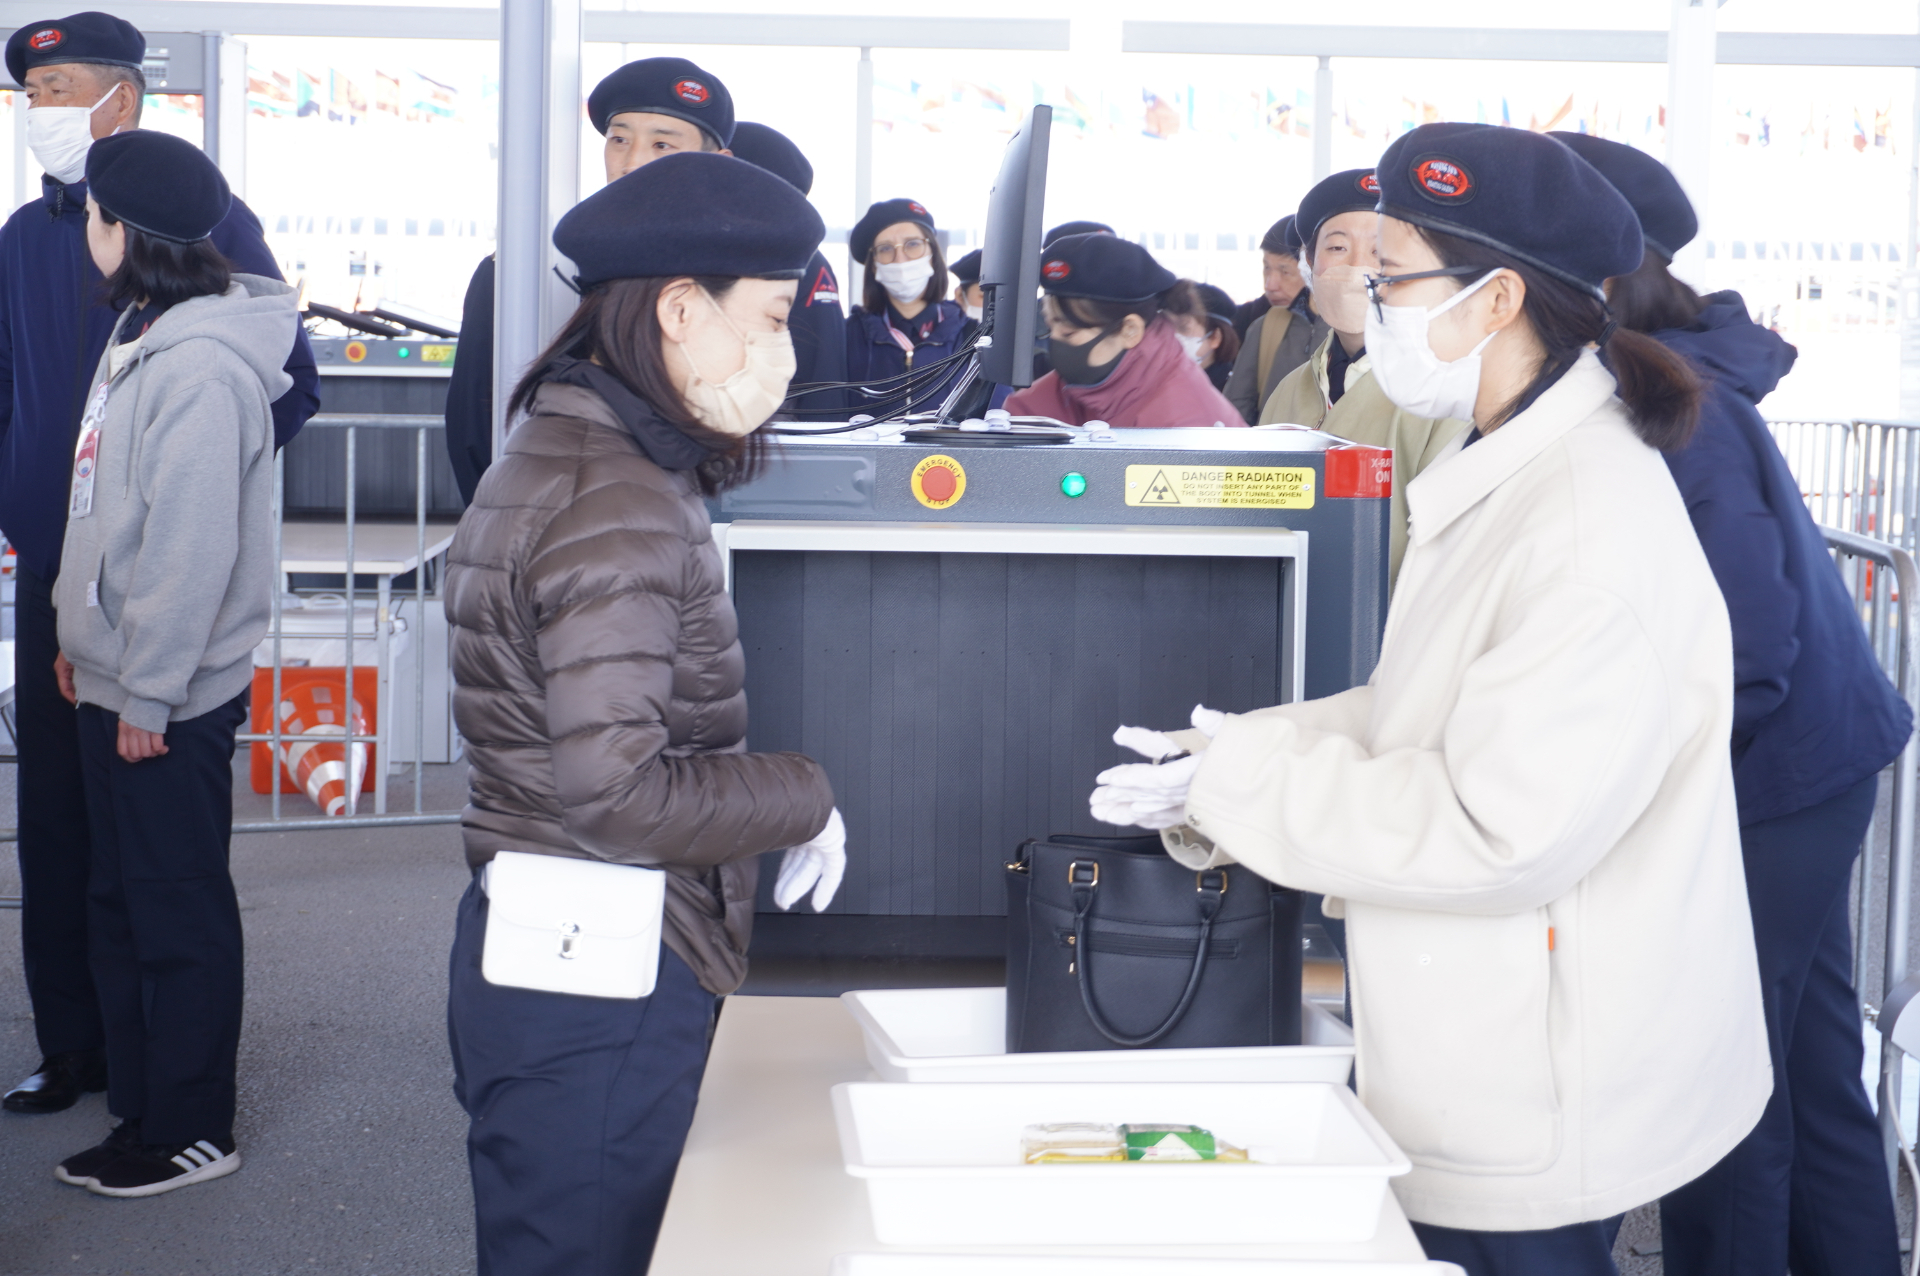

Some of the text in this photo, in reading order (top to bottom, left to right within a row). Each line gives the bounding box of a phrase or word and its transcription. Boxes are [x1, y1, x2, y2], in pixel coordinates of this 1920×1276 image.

[917, 459, 962, 478] EMERGENCY
[1371, 457, 1392, 469] X-RA
[1181, 471, 1303, 482] DANGER RADIATION
[1375, 470, 1390, 484] ON
